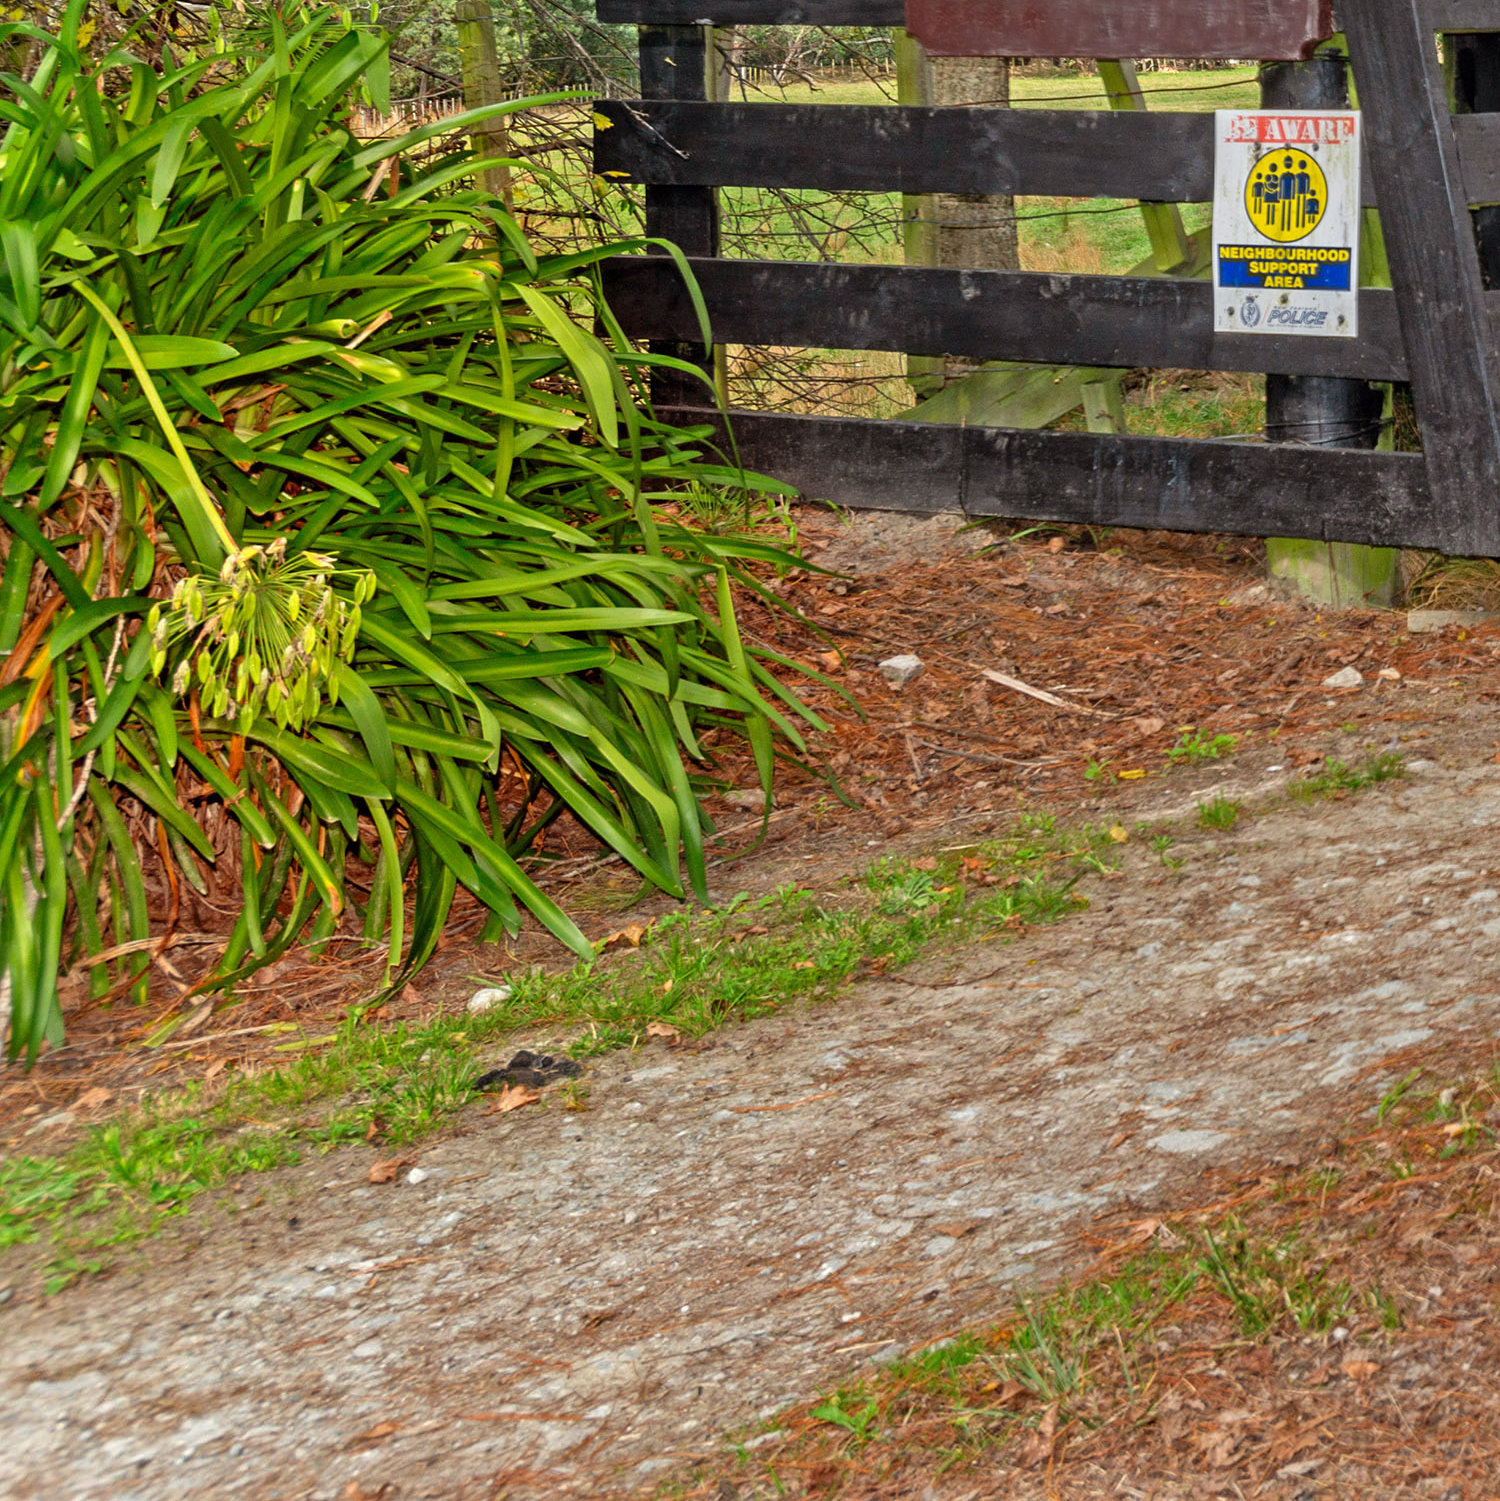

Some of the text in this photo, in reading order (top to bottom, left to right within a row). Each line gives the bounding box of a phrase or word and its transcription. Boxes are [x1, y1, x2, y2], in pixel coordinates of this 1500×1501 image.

[1264, 118, 1352, 141] AWARE
[1219, 247, 1349, 261] NEIGHBOURHOOD
[1249, 261, 1318, 275] SUPPORT
[1264, 276, 1303, 288] AREA
[1267, 309, 1328, 325] POLICE
